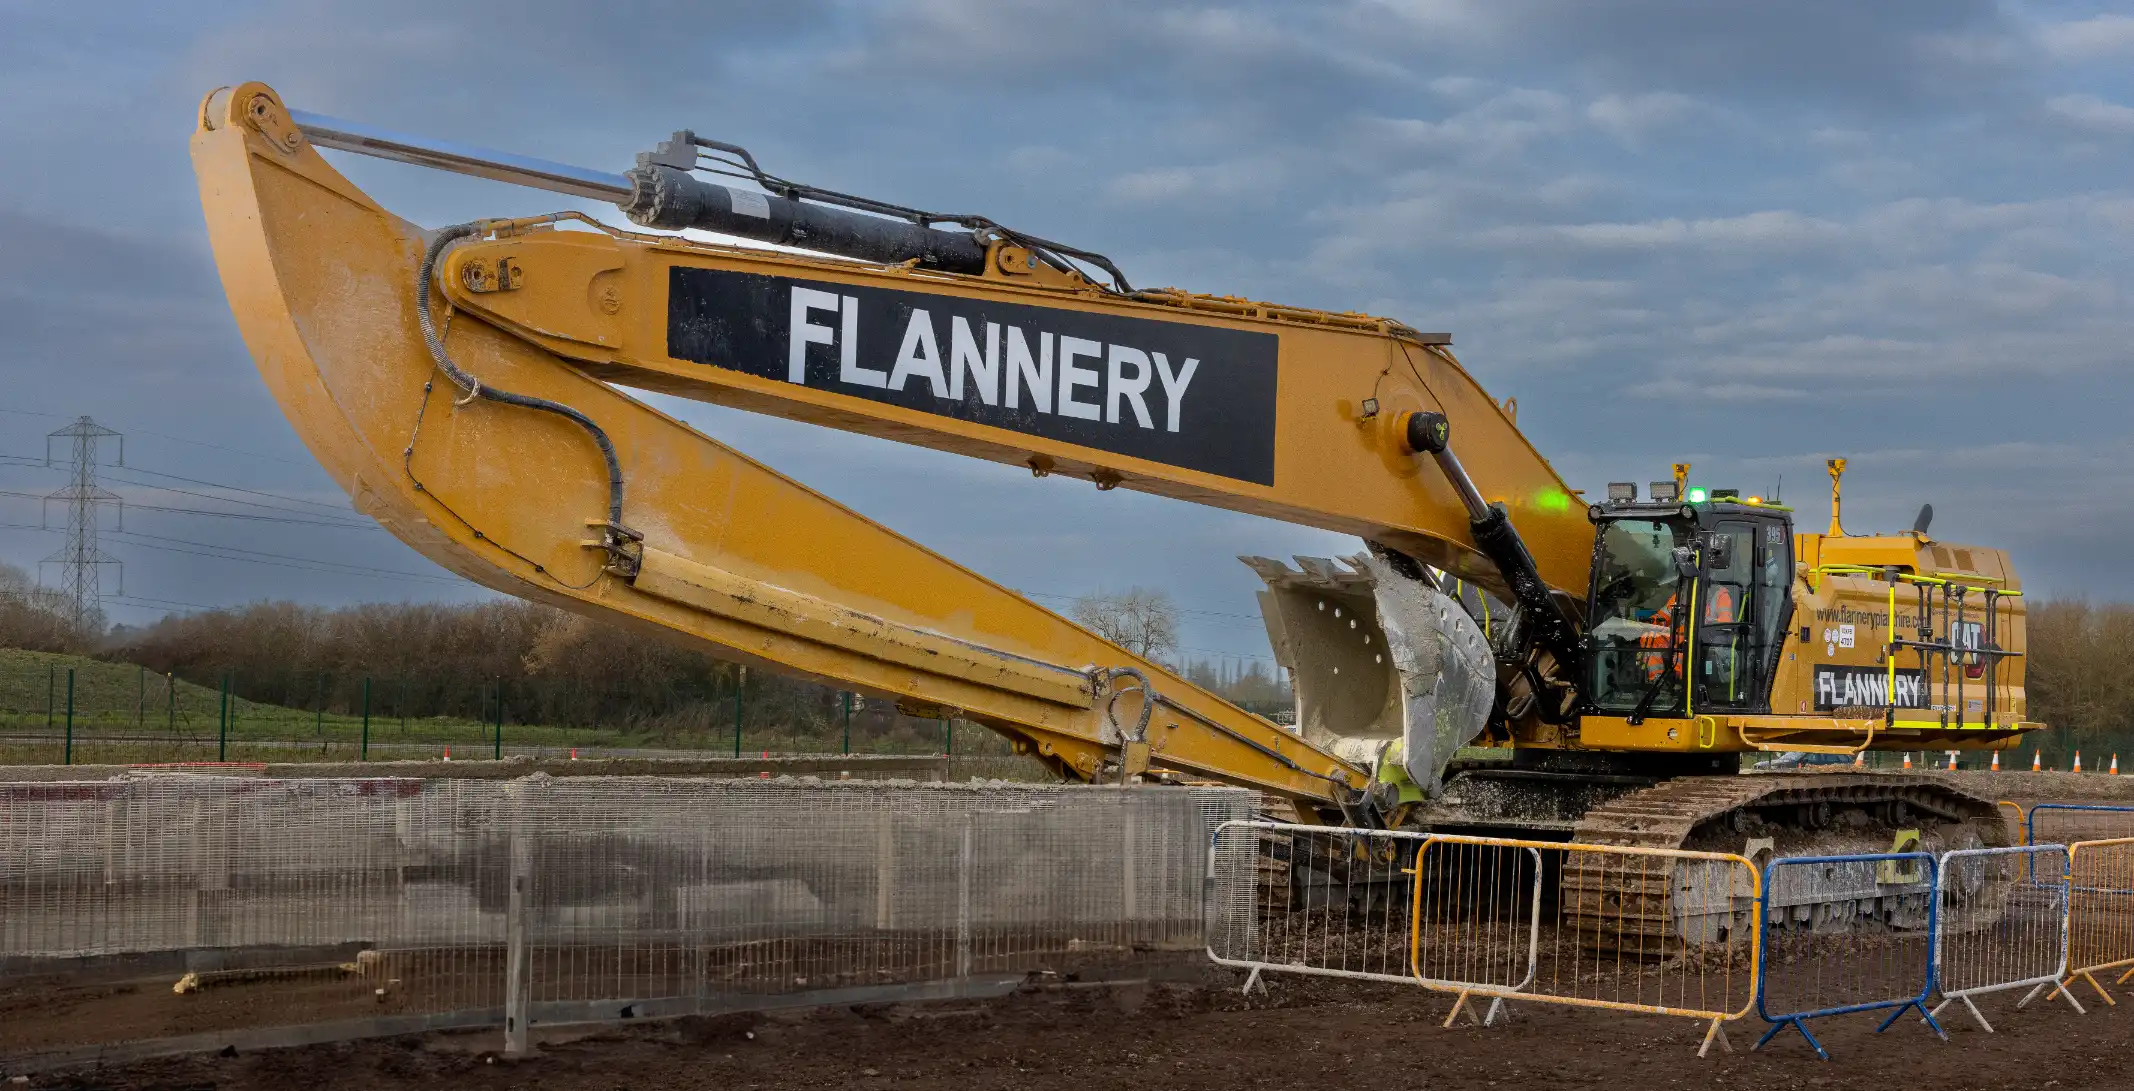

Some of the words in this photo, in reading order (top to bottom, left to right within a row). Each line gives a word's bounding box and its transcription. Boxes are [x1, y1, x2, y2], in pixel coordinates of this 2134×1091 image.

[788, 285, 1200, 432] FLANNERY
[1767, 525, 1781, 542] 395
[1816, 605, 1931, 631] www.flanneryplahire.com
[1951, 621, 1981, 665] CAT
[1819, 672, 1920, 706] FLANNERY
